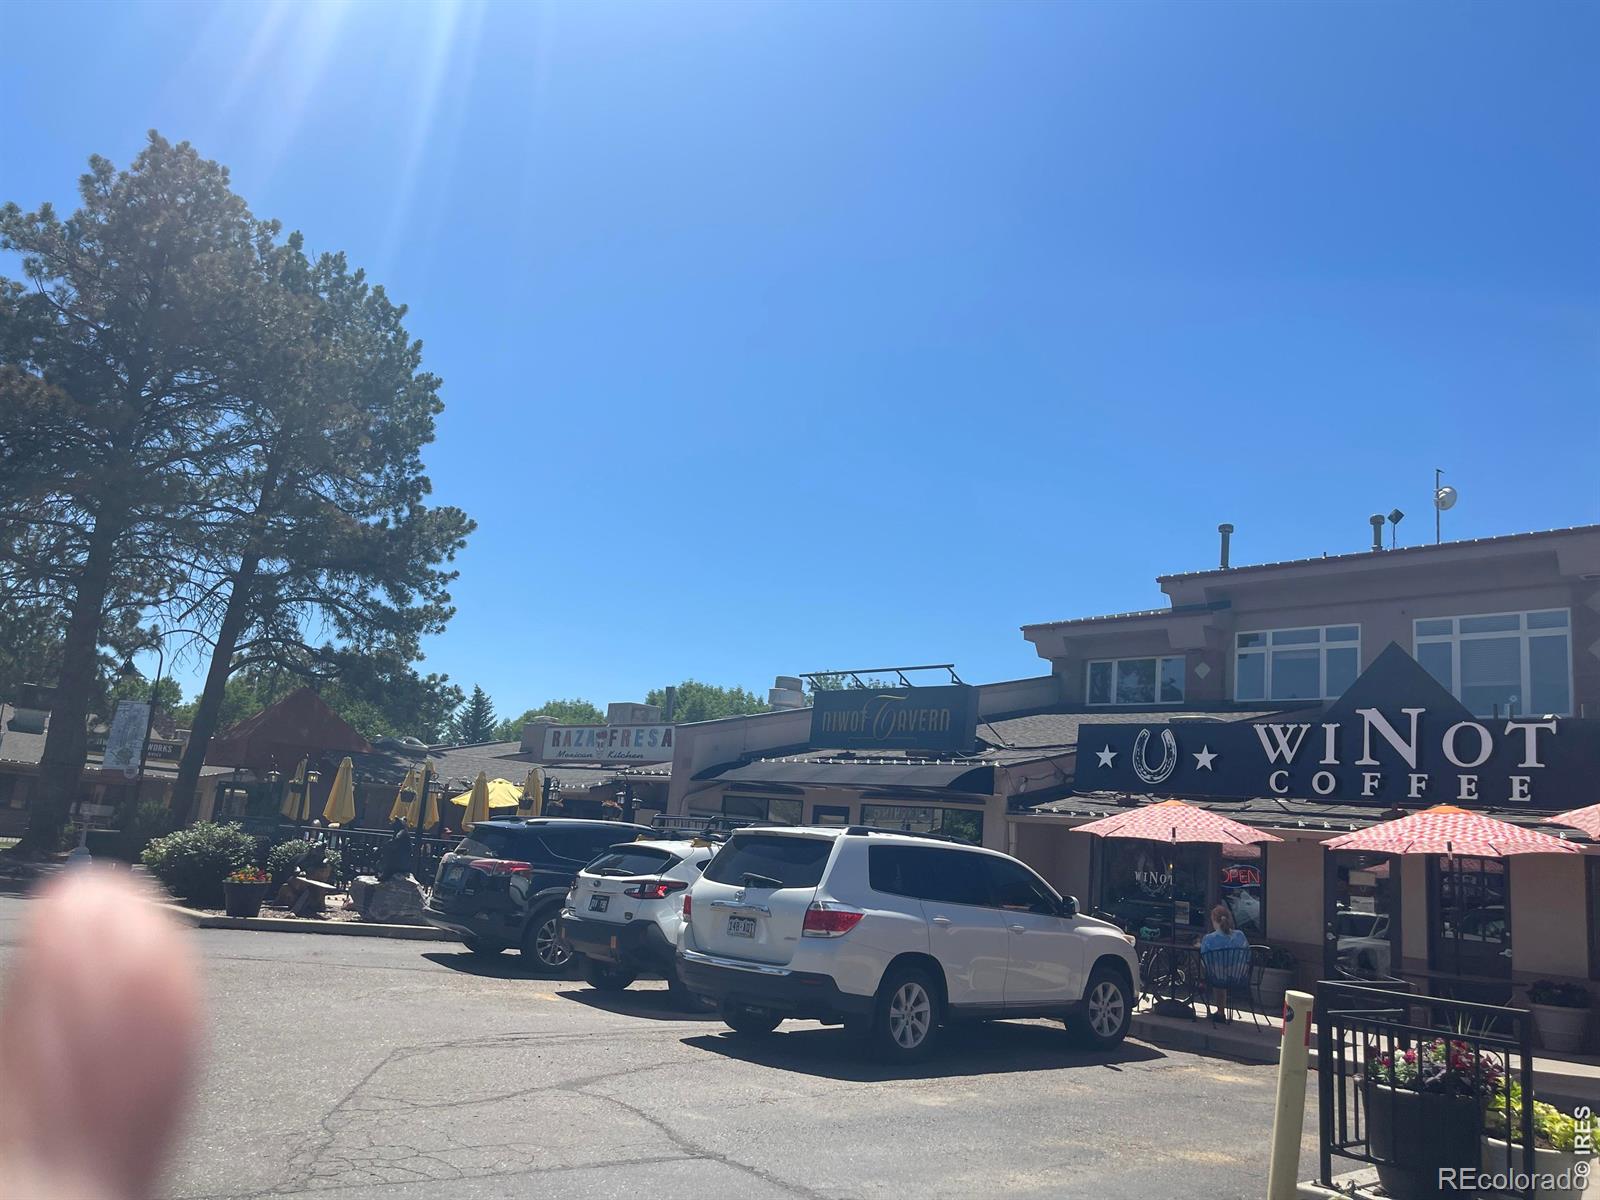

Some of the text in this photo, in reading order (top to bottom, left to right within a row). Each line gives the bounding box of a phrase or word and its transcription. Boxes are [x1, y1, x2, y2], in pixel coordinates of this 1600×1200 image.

[873, 693, 950, 741] TAVERN
[551, 728, 673, 748] RAZA FRESA
[556, 750, 644, 759] Mexican Kitchen
[1269, 770, 1532, 802] COFFEE
